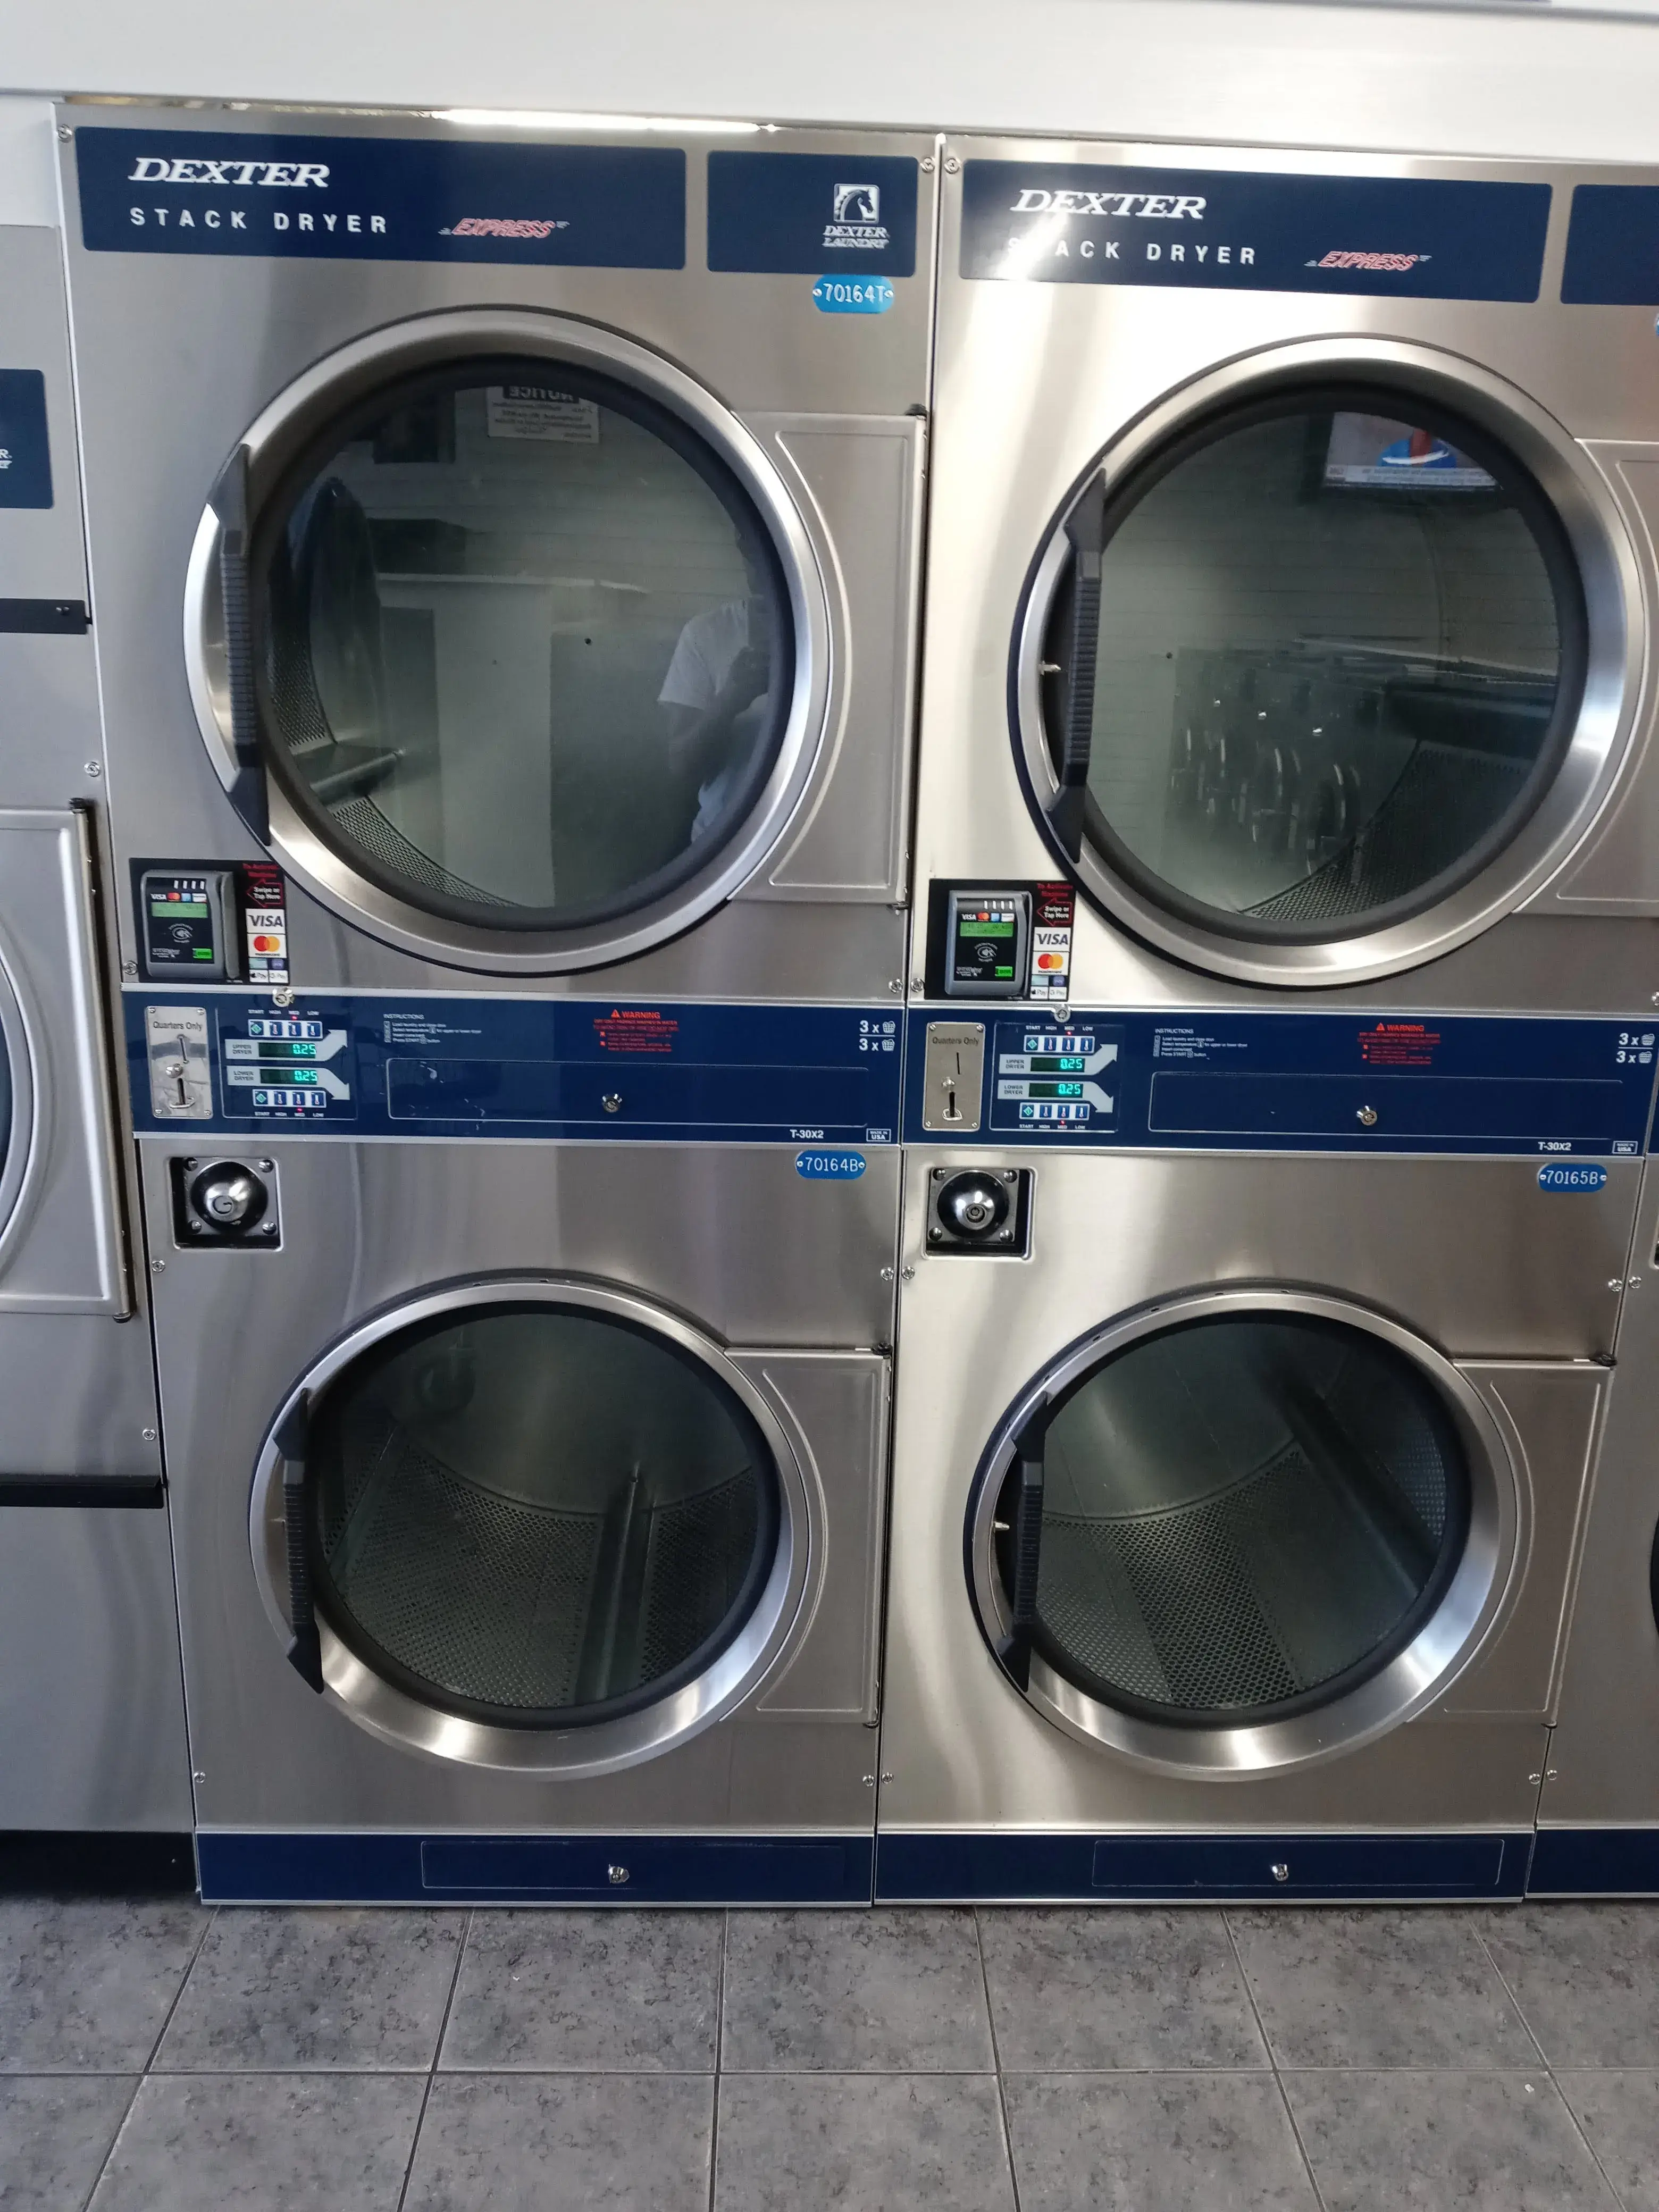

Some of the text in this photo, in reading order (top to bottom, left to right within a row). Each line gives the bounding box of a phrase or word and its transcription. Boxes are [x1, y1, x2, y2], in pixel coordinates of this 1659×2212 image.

[128, 157, 330, 188] DEXTER
[1010, 189, 1207, 220] DEXTER
[130, 207, 386, 233] STACK DRYER
[451, 218, 556, 238] EXPRESS
[823, 225, 889, 238] DEXTER
[822, 238, 890, 249] LAUNDRY
[1008, 238, 1255, 265] SACK DRYER
[1317, 251, 1418, 271] EXPRESS
[823, 283, 885, 303] 70164T
[248, 915, 283, 927] VISA
[1036, 933, 1068, 945] VISA
[153, 1021, 203, 1031] Quarters Only
[859, 1020, 879, 1033] 3 x
[859, 1038, 879, 1051] 3 x
[963, 1037, 979, 1046] Only
[1619, 1033, 1639, 1046] 3 x
[1616, 1051, 1636, 1063] 3 x
[790, 1129, 824, 1138] T-30X2
[1538, 1142, 1571, 1151] T-30X2
[805, 1157, 858, 1172] 70164B
[1546, 1170, 1598, 1185] 70165B
